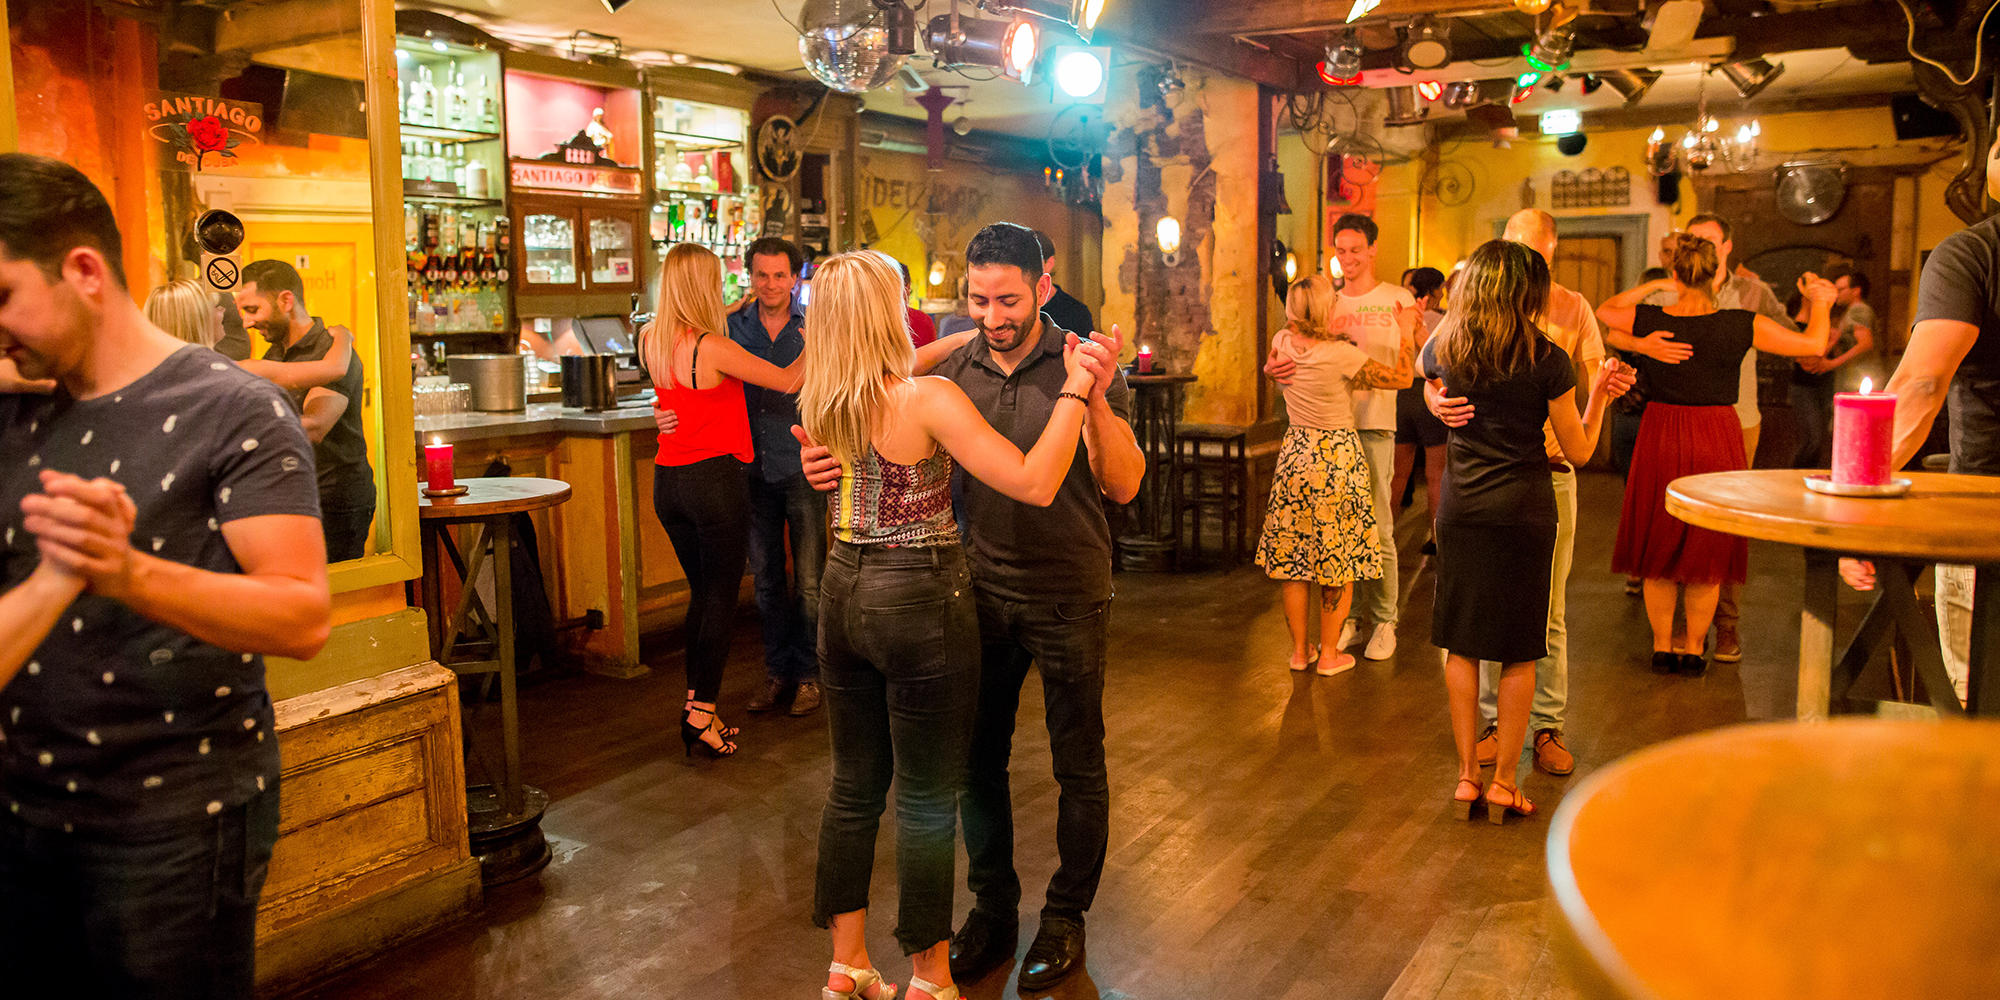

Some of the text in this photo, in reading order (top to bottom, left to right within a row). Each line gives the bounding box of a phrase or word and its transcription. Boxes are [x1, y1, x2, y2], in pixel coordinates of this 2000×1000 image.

[144, 97, 262, 132] SANTIAGO
[512, 167, 583, 184] SANTIAGO
[1356, 305, 1392, 313] JACK&
